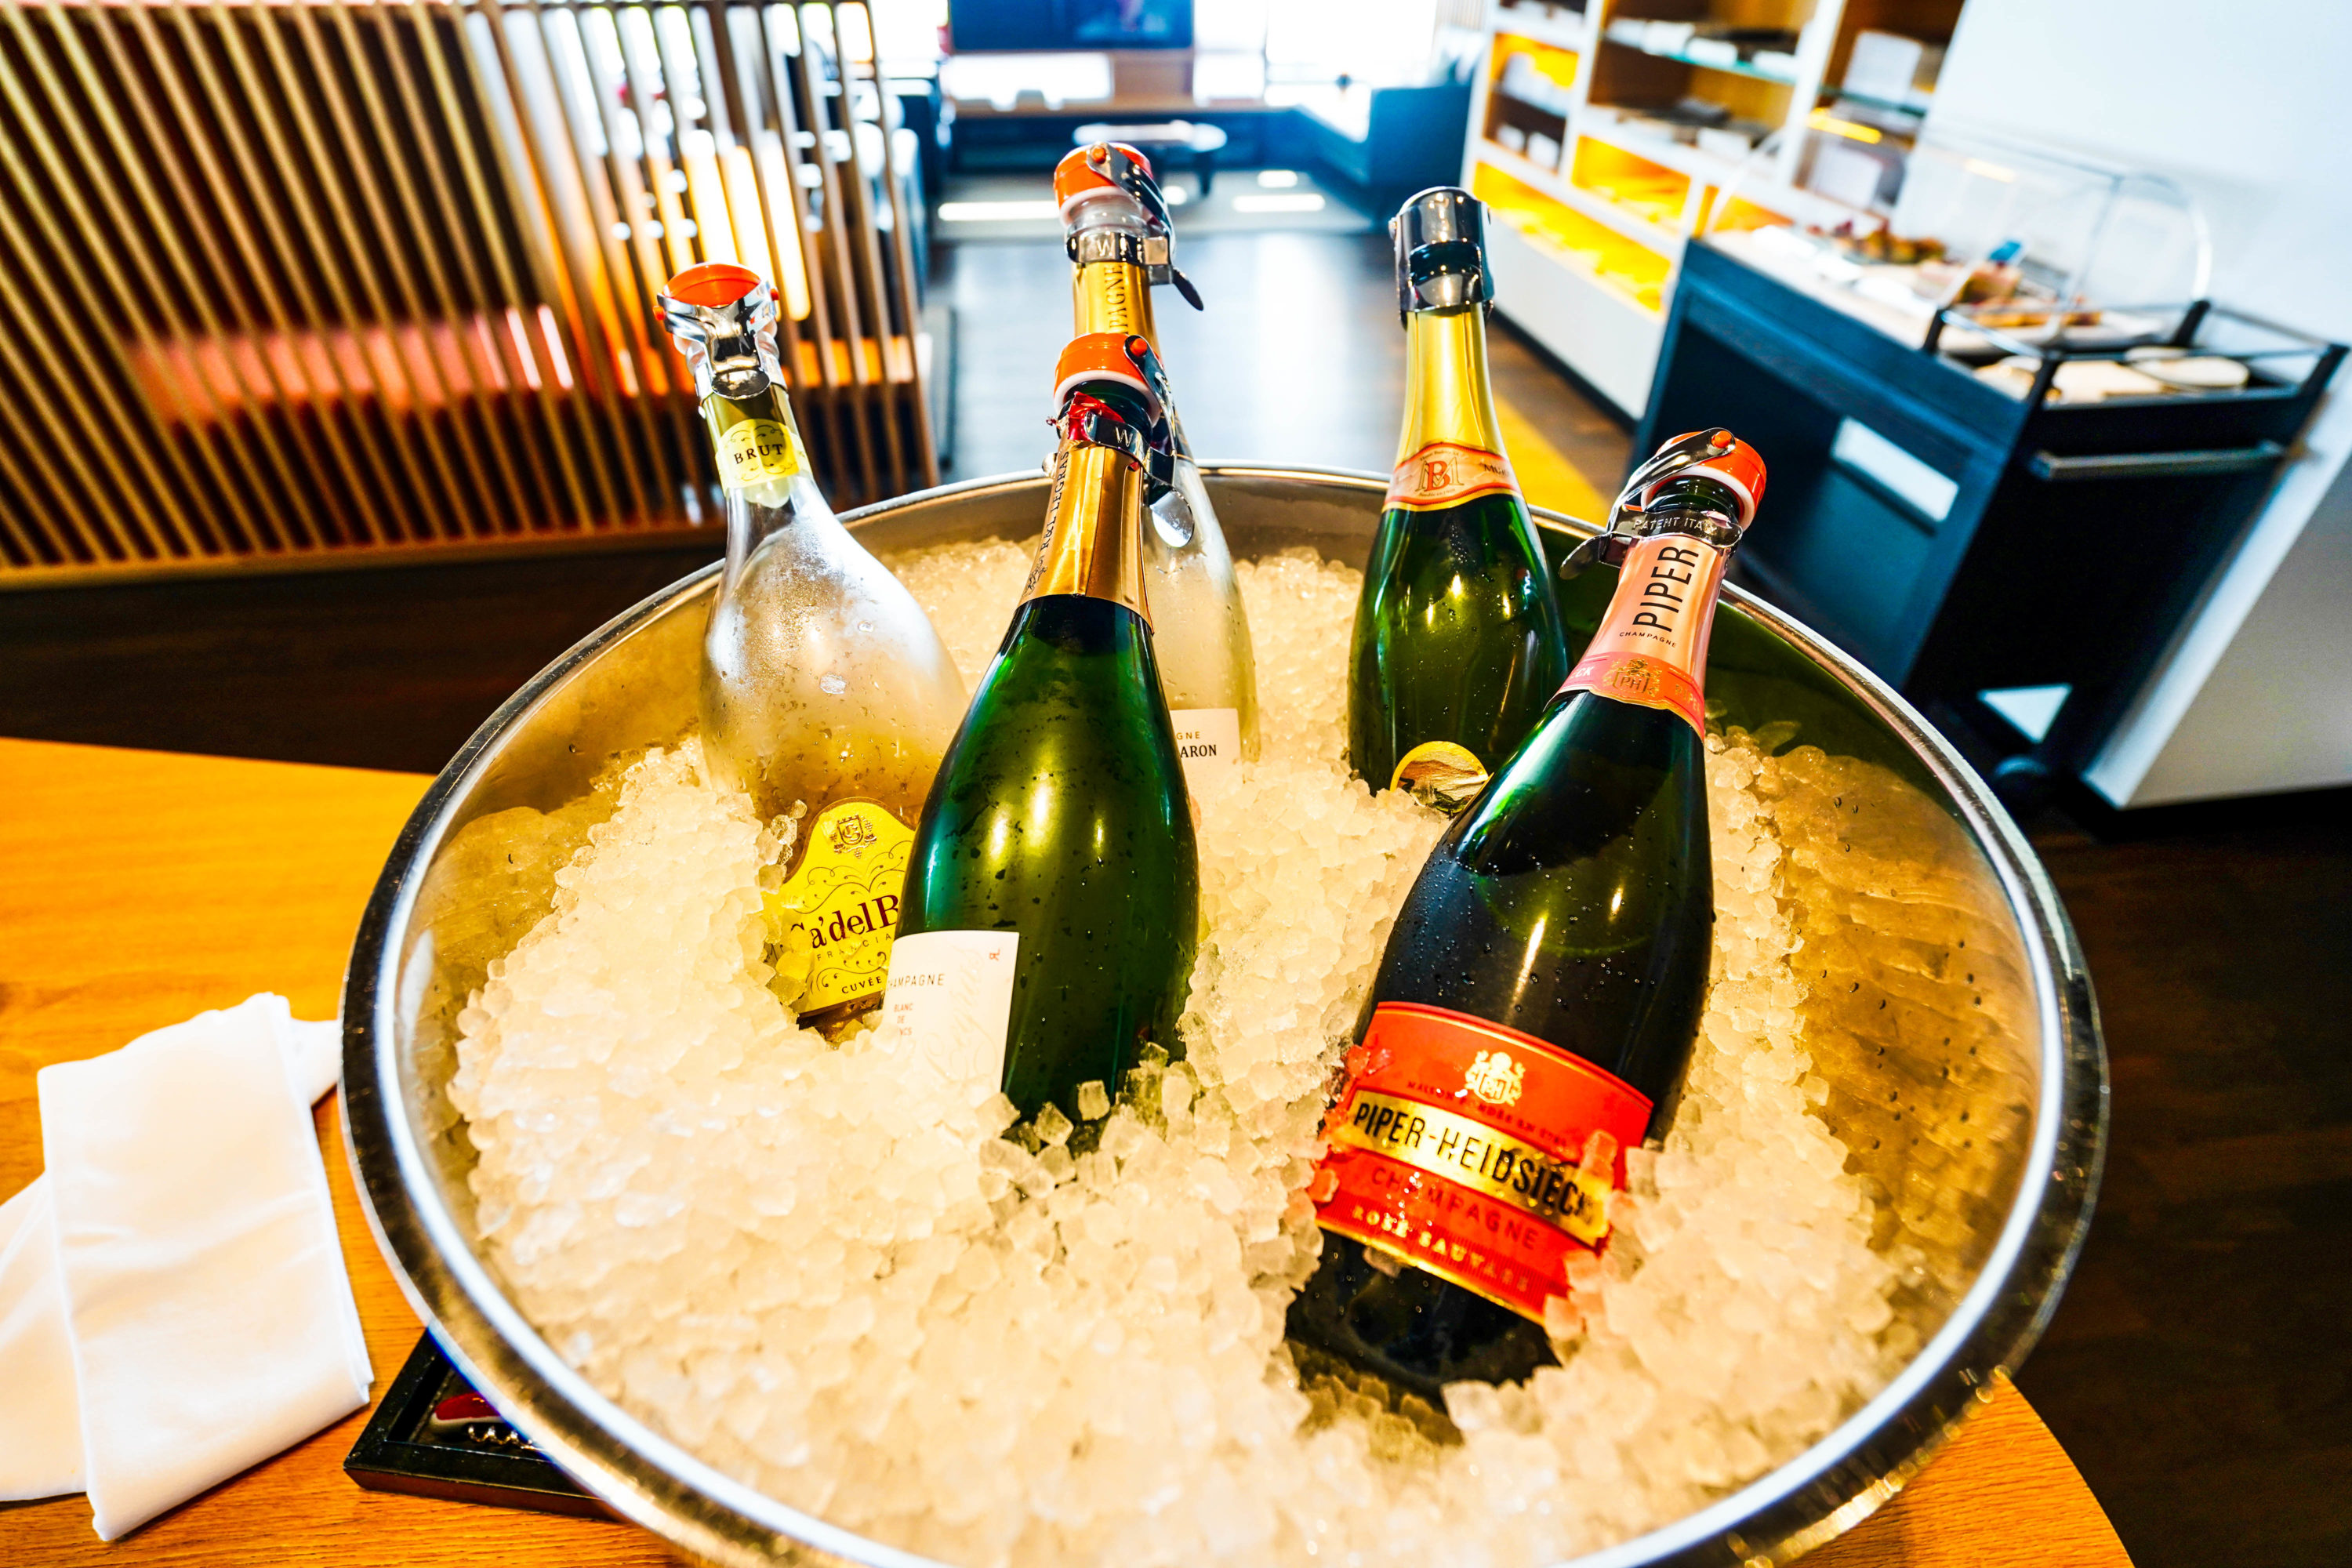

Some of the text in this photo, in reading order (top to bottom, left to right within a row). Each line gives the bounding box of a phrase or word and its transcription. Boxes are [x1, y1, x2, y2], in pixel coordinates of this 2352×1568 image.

[1104, 265, 1128, 334] PAGNE
[735, 443, 784, 465] BRUT
[1051, 451, 1069, 515] LEGRAS
[1632, 517, 1680, 530] PATENT
[1632, 546, 1699, 632] PIPER
[1619, 631, 1677, 648] CHAMPAGNE
[841, 976, 882, 994] CUVÉE
[1459, 1096, 1513, 1124] FNDÉE
[1371, 1166, 1538, 1250] CHMPAGNE
